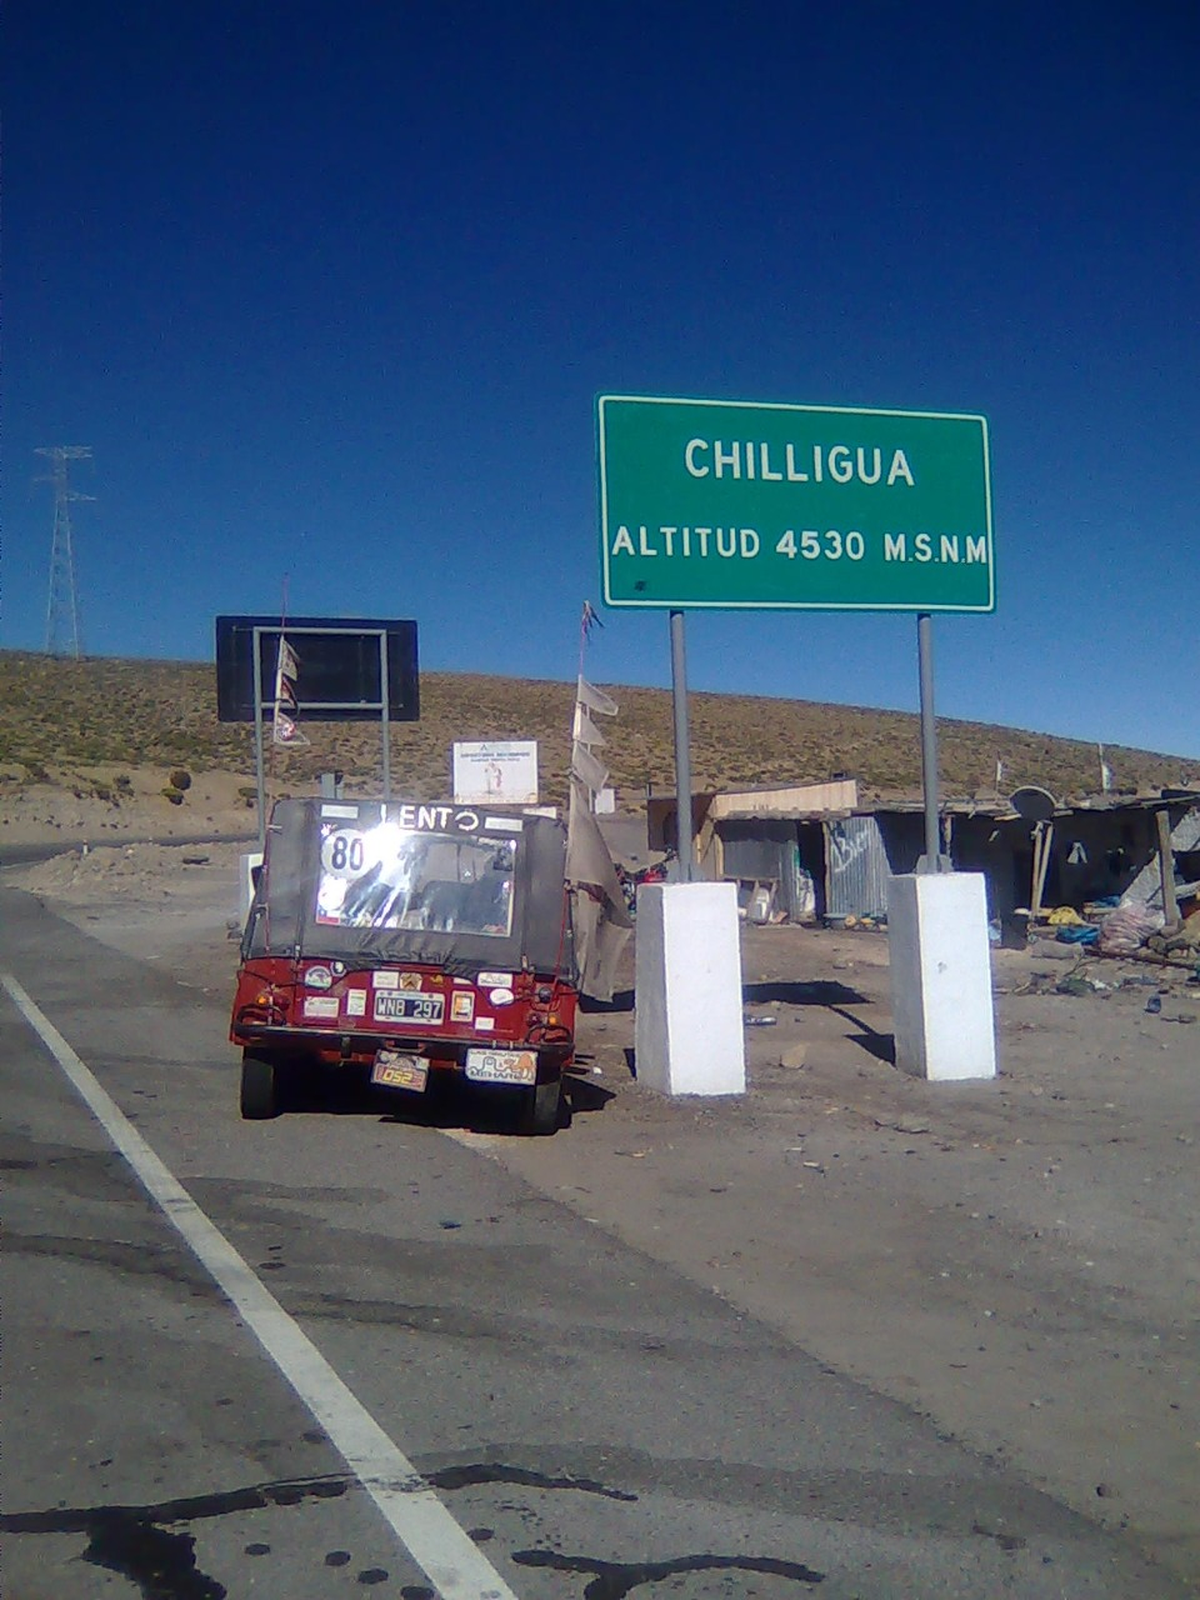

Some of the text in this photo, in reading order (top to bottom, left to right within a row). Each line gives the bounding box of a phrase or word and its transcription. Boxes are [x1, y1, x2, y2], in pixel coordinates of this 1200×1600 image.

[684, 438, 915, 486] CHILLIGUA
[611, 525, 988, 564] ALTITUD 4530 M.S.N.M
[331, 836, 364, 870] 80
[413, 1001, 441, 1020] 297
